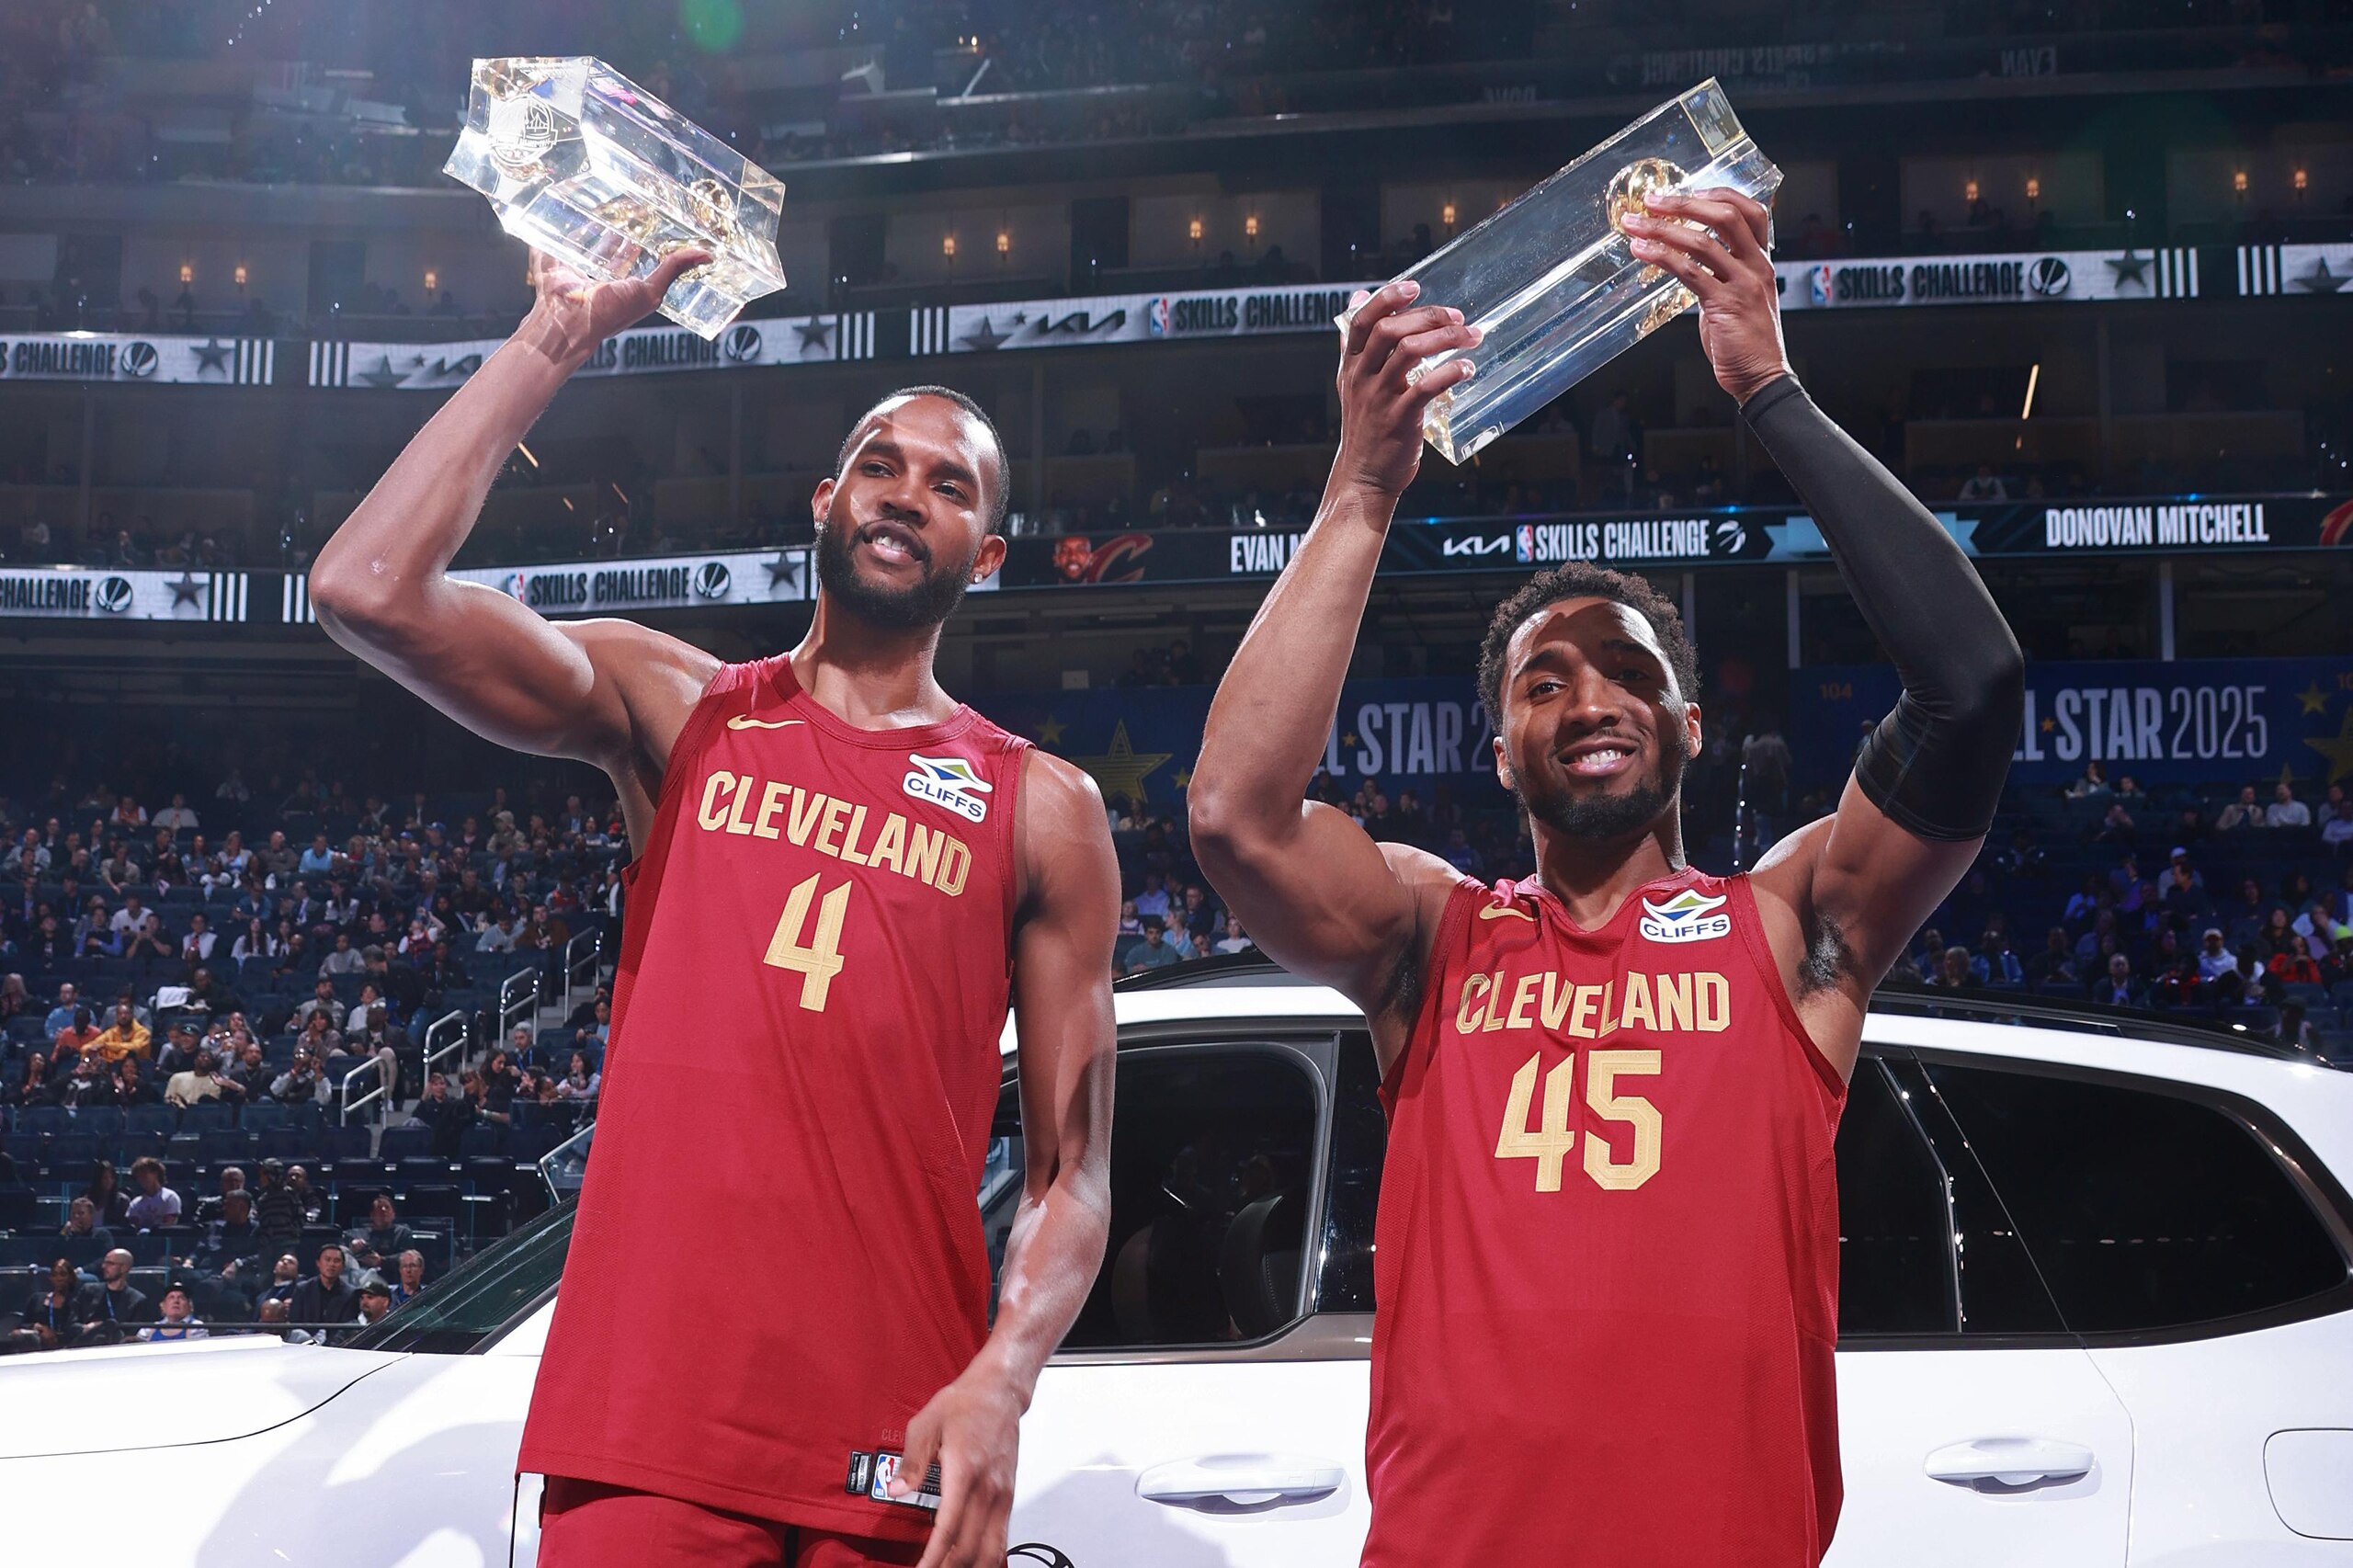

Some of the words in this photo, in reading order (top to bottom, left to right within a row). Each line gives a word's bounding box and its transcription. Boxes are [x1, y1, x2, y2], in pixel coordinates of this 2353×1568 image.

[1839, 266, 1905, 300] SKILLS
[1913, 262, 2024, 297] CHALLENGE
[1039, 310, 1126, 334] KIA
[1175, 297, 1239, 330] SKILLS
[16, 342, 116, 374] CHALLENGE
[1443, 535, 1510, 555] KIA
[1535, 523, 1598, 562] SKILLS
[1604, 519, 1711, 559] CHALLENGE
[2046, 506, 2153, 547] DONOVAN
[2158, 504, 2269, 544] MITCHELL
[1231, 534, 1284, 573] EVAN
[530, 574, 587, 606] SKILLS
[595, 567, 689, 603] CHALLENGE
[1819, 682, 1853, 700] 104
[1357, 701, 1463, 776] STAR
[2055, 688, 2164, 761] STAR
[2170, 686, 2268, 759] 2025
[907, 778, 983, 818] CLIFFS
[697, 770, 972, 897] CLEVELAND
[763, 871, 852, 1013] 4
[1643, 919, 1727, 938] CLIFFS
[1455, 971, 1730, 1039] CLEVELAND
[1495, 1050, 1663, 1192] 45
